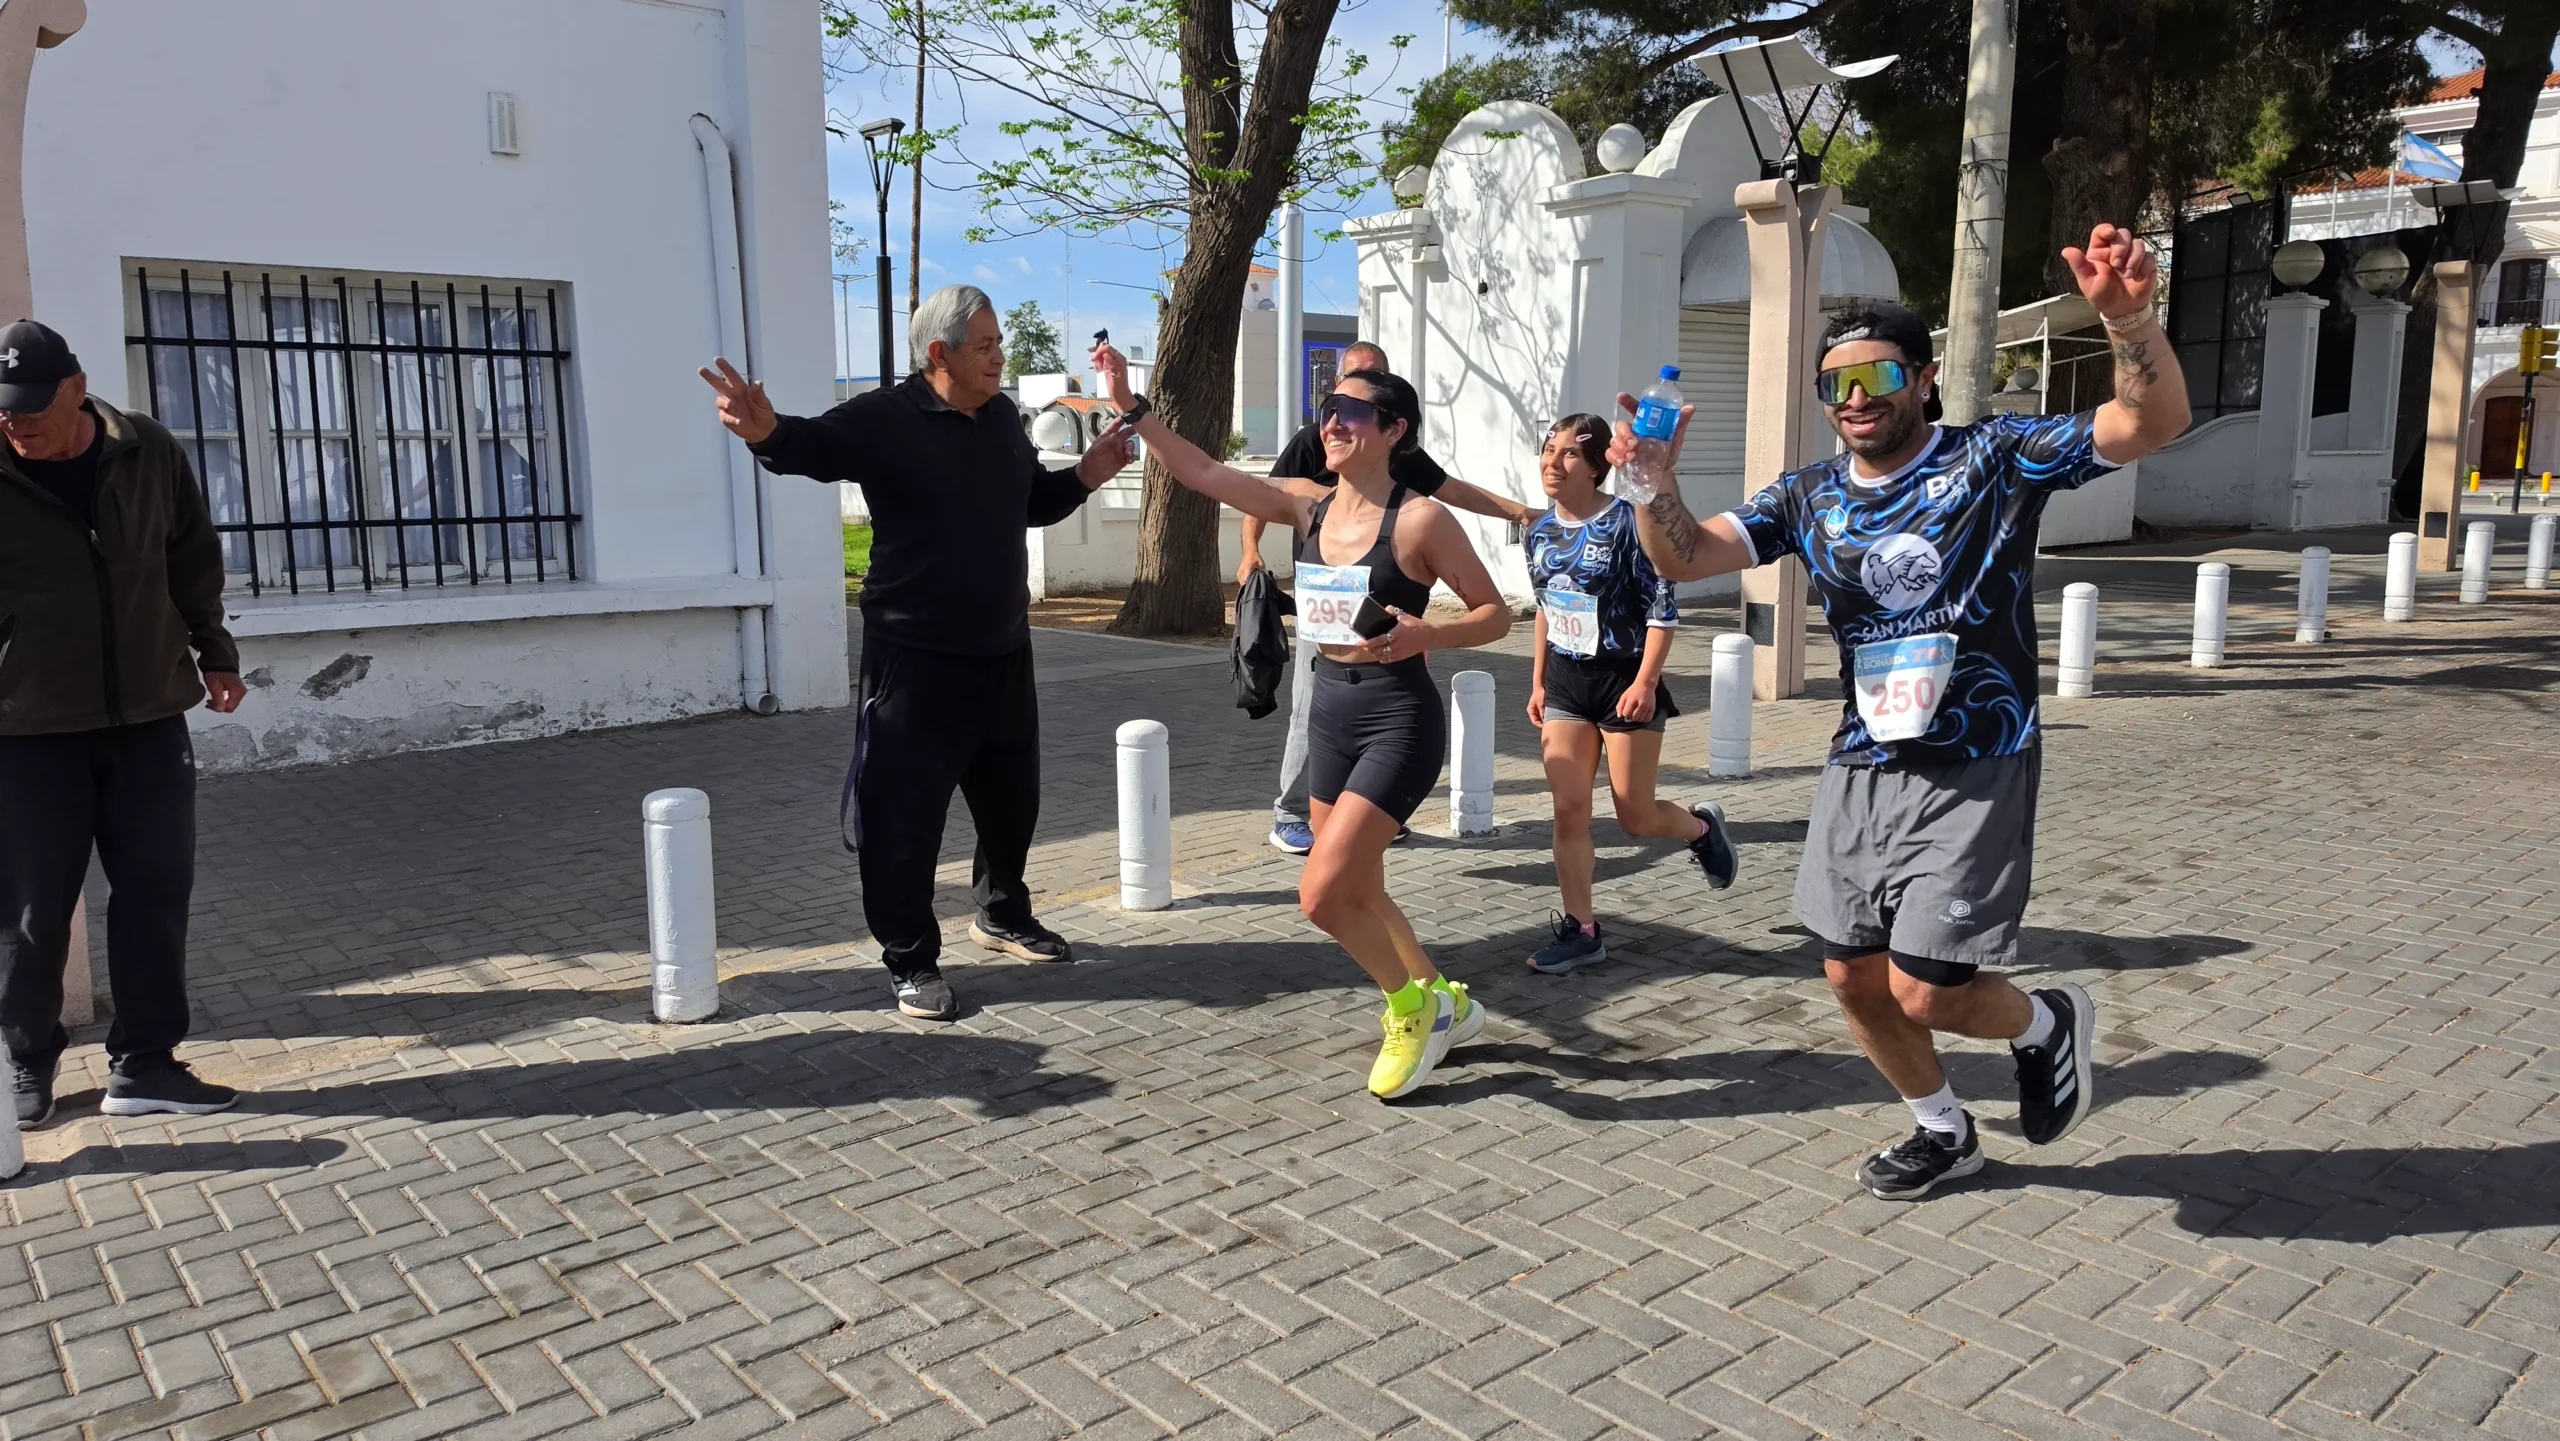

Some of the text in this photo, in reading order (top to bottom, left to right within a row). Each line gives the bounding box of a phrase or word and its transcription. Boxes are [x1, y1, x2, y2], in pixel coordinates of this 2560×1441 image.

[1305, 597, 1353, 625] 295
[1862, 621, 1894, 642] SAN
[1870, 676, 1936, 717] 250
